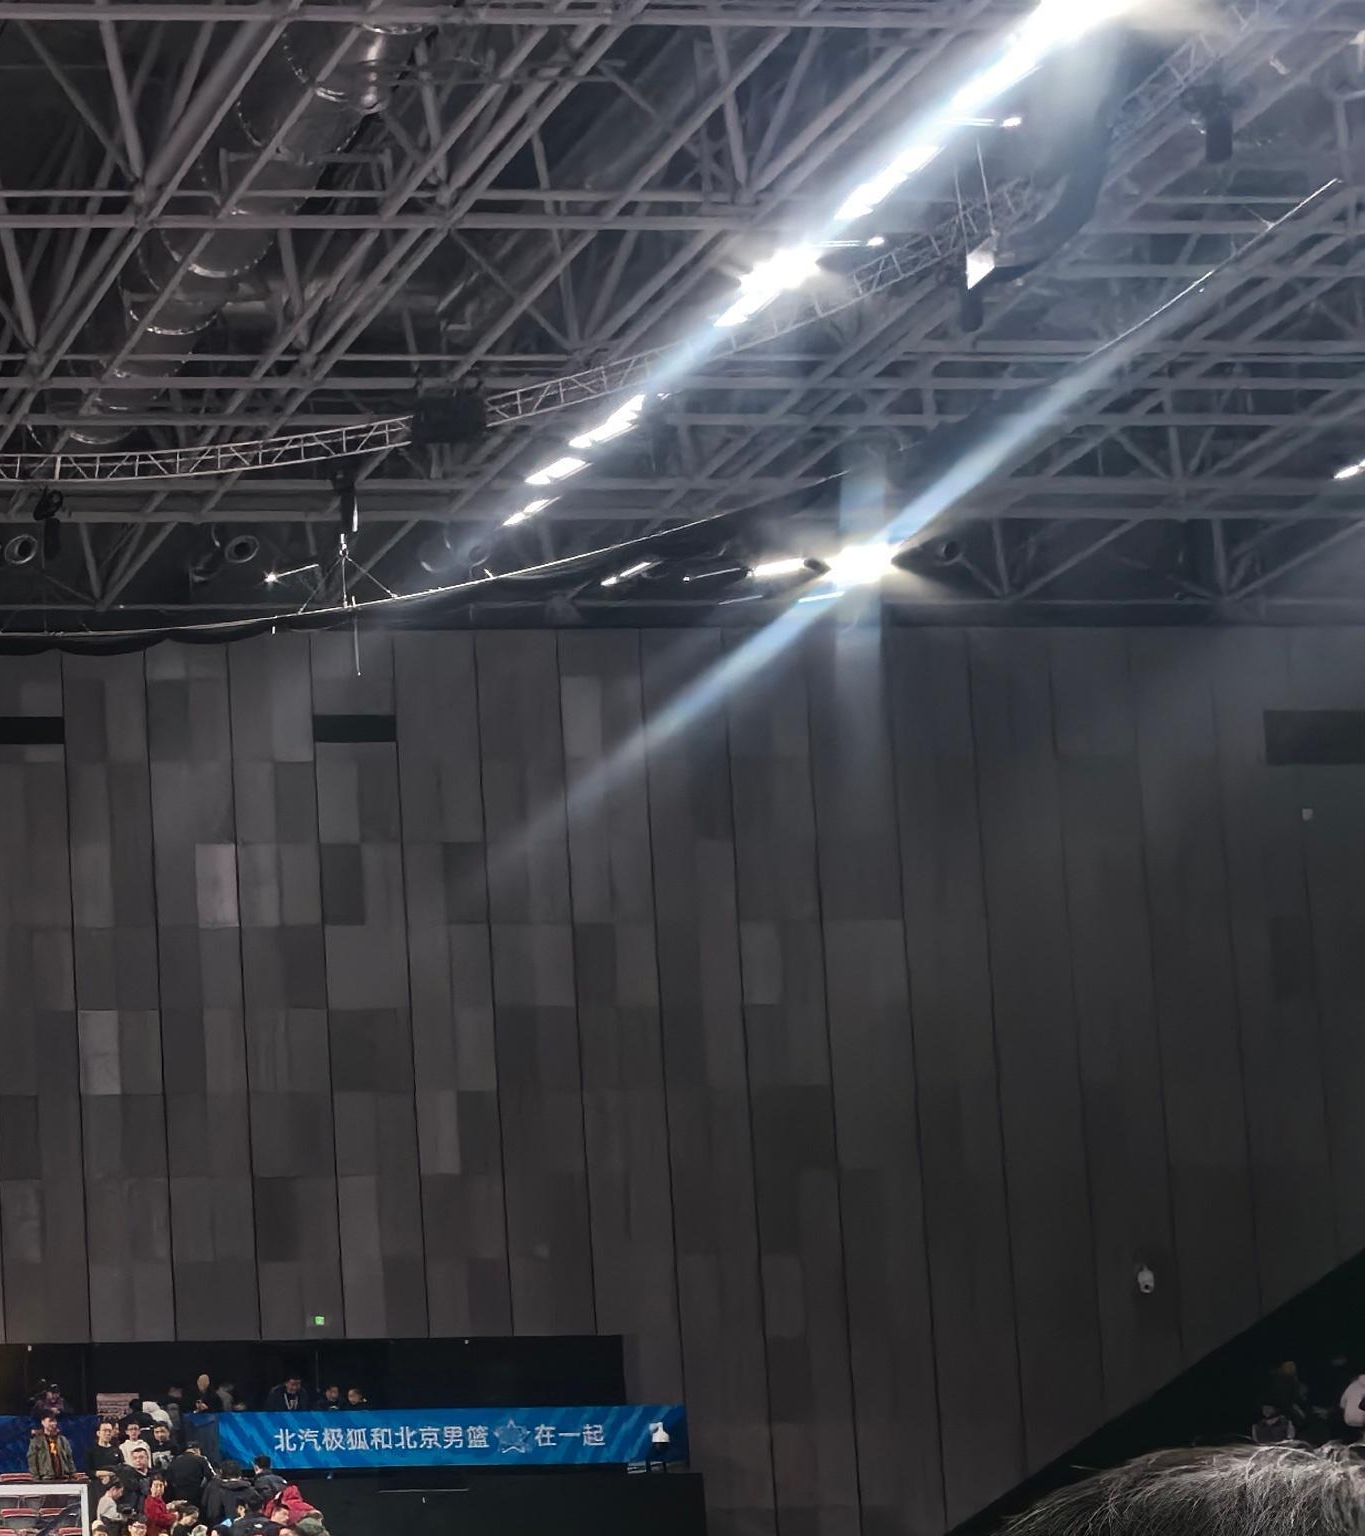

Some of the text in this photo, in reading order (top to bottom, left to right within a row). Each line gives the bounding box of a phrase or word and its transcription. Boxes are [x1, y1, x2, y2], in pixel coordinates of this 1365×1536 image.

[273, 1423, 607, 1453] 北汽极狐和北京男篮 在一起
